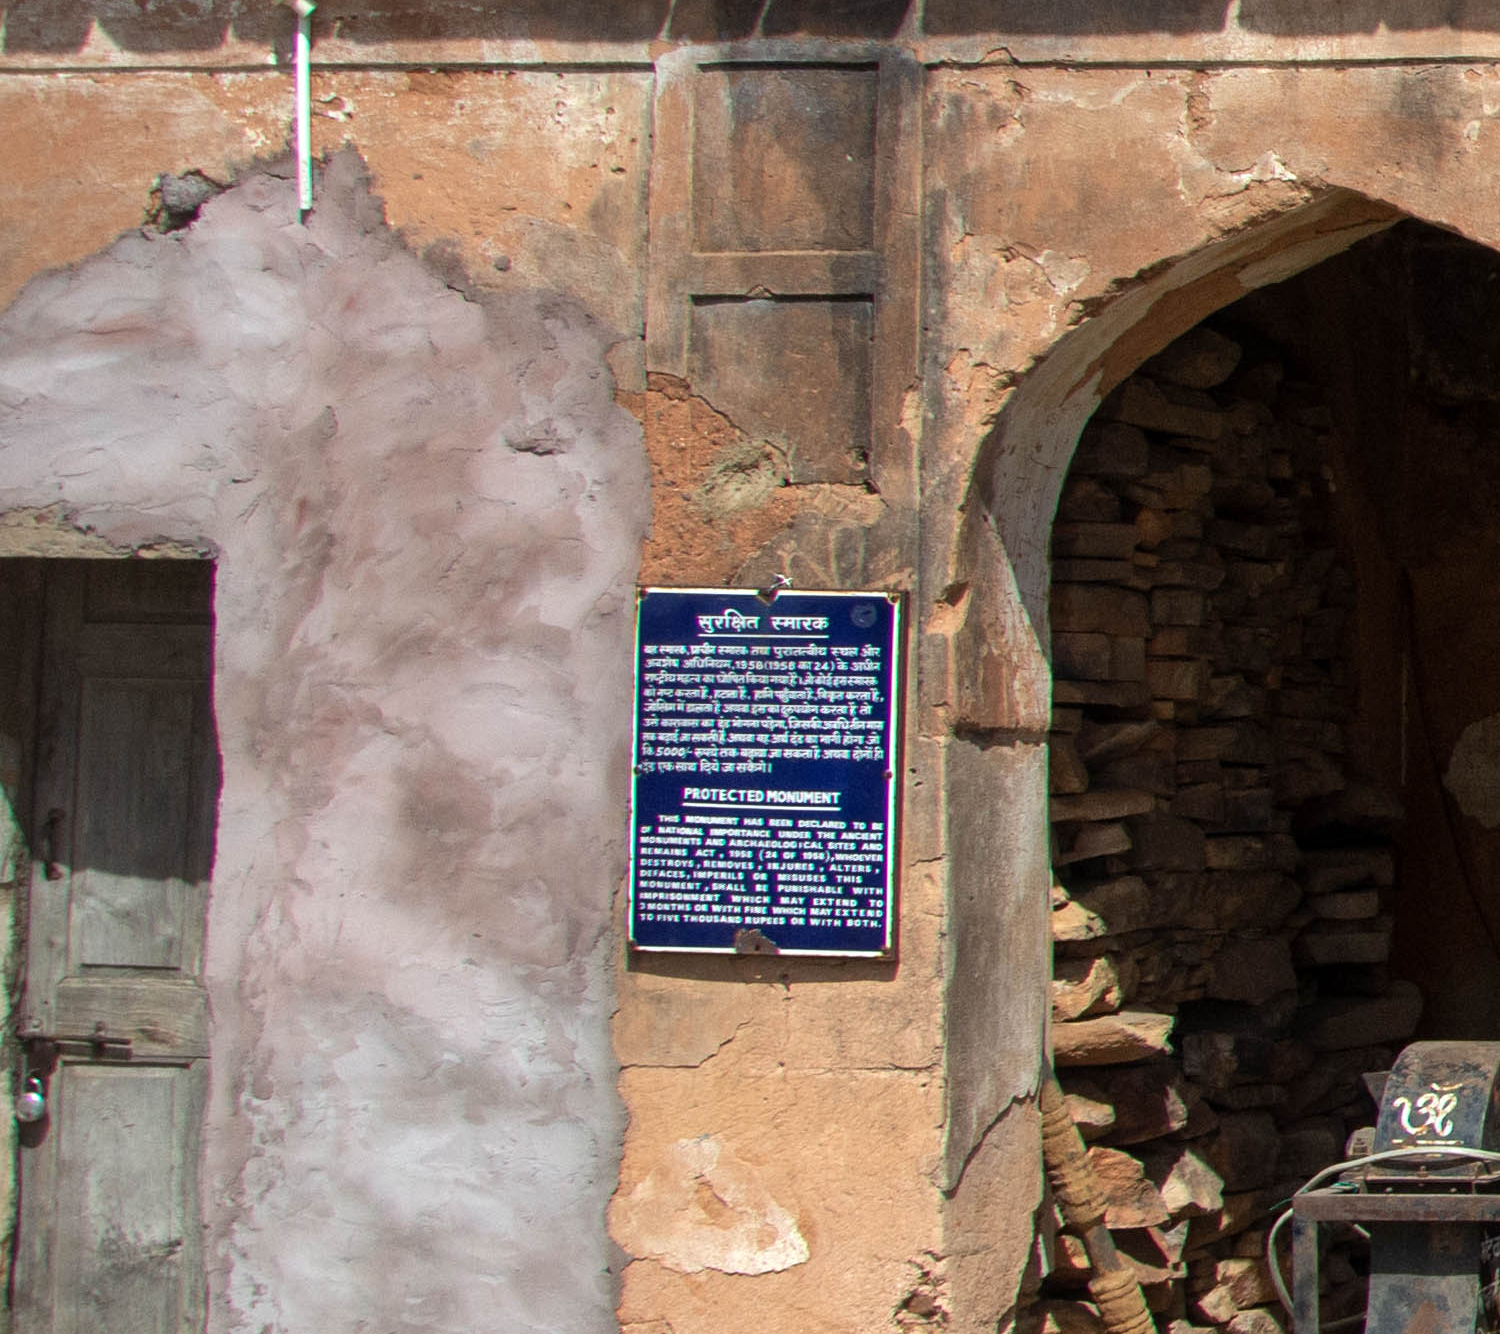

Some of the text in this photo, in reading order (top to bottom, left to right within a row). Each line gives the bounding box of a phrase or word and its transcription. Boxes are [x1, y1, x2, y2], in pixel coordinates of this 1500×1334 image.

[698, 610, 828, 633] सुरक्षित स्मारक
[684, 788, 840, 804] PROTECTED MONUMENT
[685, 816, 738, 825] MONUMENT
[744, 818, 763, 826] HAS
[768, 819, 792, 827] BEEN
[798, 820, 846, 829] DECLARED
[853, 822, 866, 830] TO
[658, 827, 703, 835] NATIONAL
[710, 828, 770, 837] IMPORTANCE
[817, 831, 835, 839] THE
[841, 832, 882, 840] ANCIENT
[640, 837, 702, 845] MONUMENTS
[705, 838, 726, 846] AND
[729, 839, 823, 849] ARCHAEOLOGICAL
[828, 842, 856, 850] SITES
[640, 848, 687, 856] REMAINS
[729, 850, 752, 858] 1958
[640, 871, 690, 879] DEFACES,
[693, 872, 744, 880] IMPERILS
[777, 874, 826, 882] MISUSES
[836, 875, 862, 883] THIS
[712, 883, 746, 891] SHALL
[755, 884, 768, 892] BE
[778, 885, 842, 893] PUNISHABLE
[852, 887, 883, 895] WITH
[640, 893, 720, 901] IMPRISONMENT
[731, 895, 770, 904] WHICH
[813, 898, 857, 907] EXTEND
[869, 899, 883, 907] TO
[647, 903, 691, 911] MONTHS
[694, 904, 708, 912] OR
[712, 905, 741, 913] WITH
[744, 906, 766, 914] FINE
[772, 907, 806, 915] WHICH
[835, 909, 882, 917] EXTEND
[657, 914, 679, 922] FIVE
[683, 915, 742, 923] THOUSAND
[745, 916, 785, 925] RUPEES
[790, 917, 804, 925] OR
[810, 918, 841, 926] WITH
[846, 919, 881, 927] BOTH.
